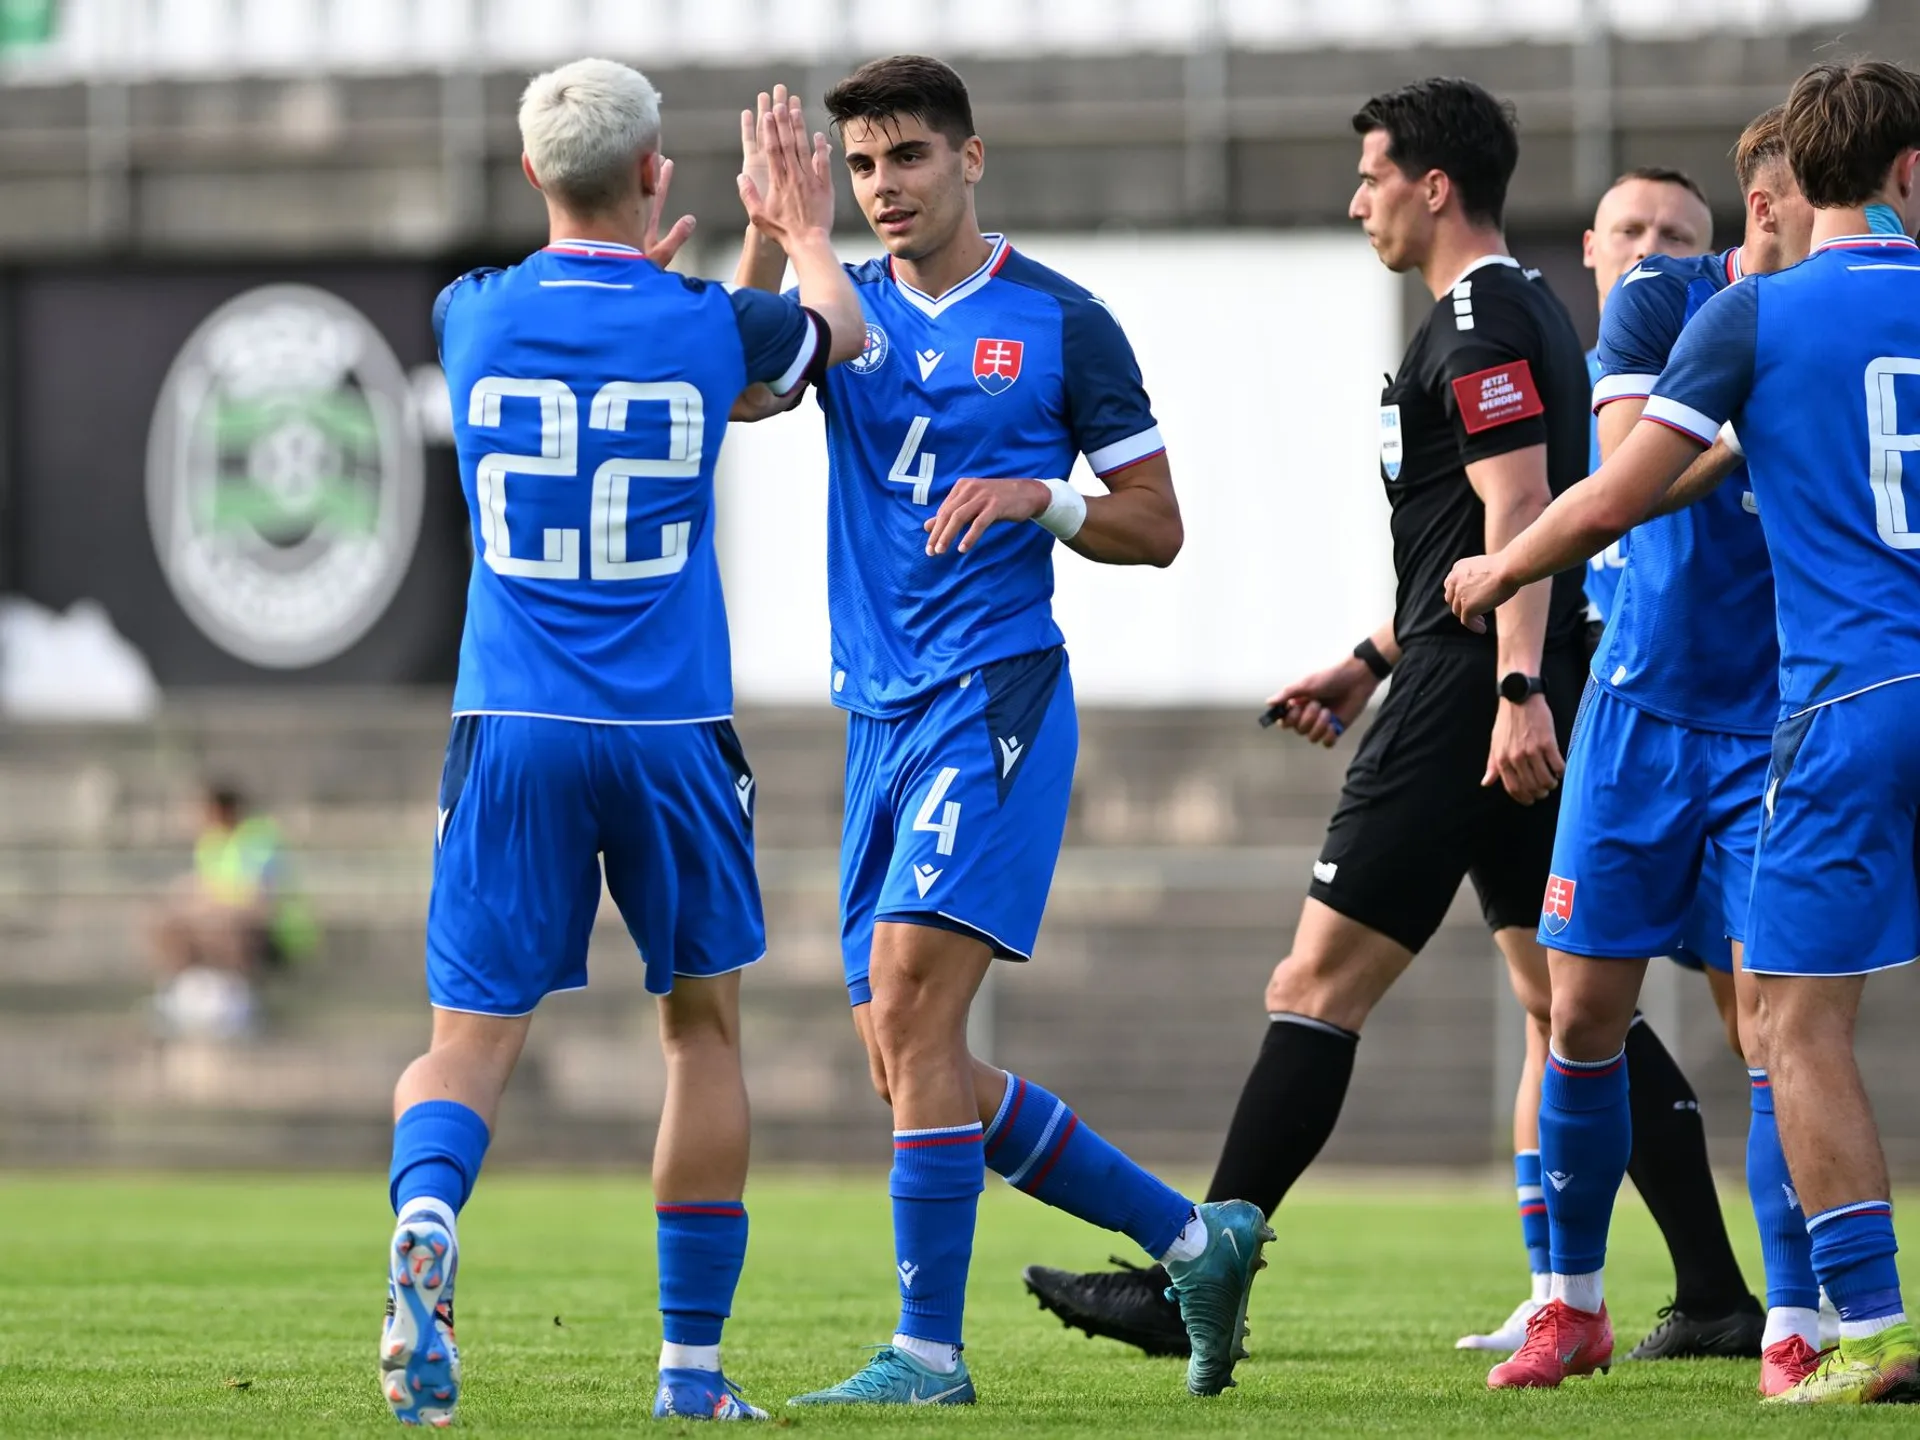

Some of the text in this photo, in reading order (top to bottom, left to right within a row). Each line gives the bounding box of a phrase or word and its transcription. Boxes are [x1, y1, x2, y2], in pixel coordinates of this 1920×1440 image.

[1478, 391, 1523, 412] WERDEN!
[1480, 373, 1509, 390] JETZT
[1481, 383, 1514, 400] SCHIRI
[468, 376, 704, 580] 22
[888, 416, 936, 505] 4
[913, 767, 961, 856] 4
